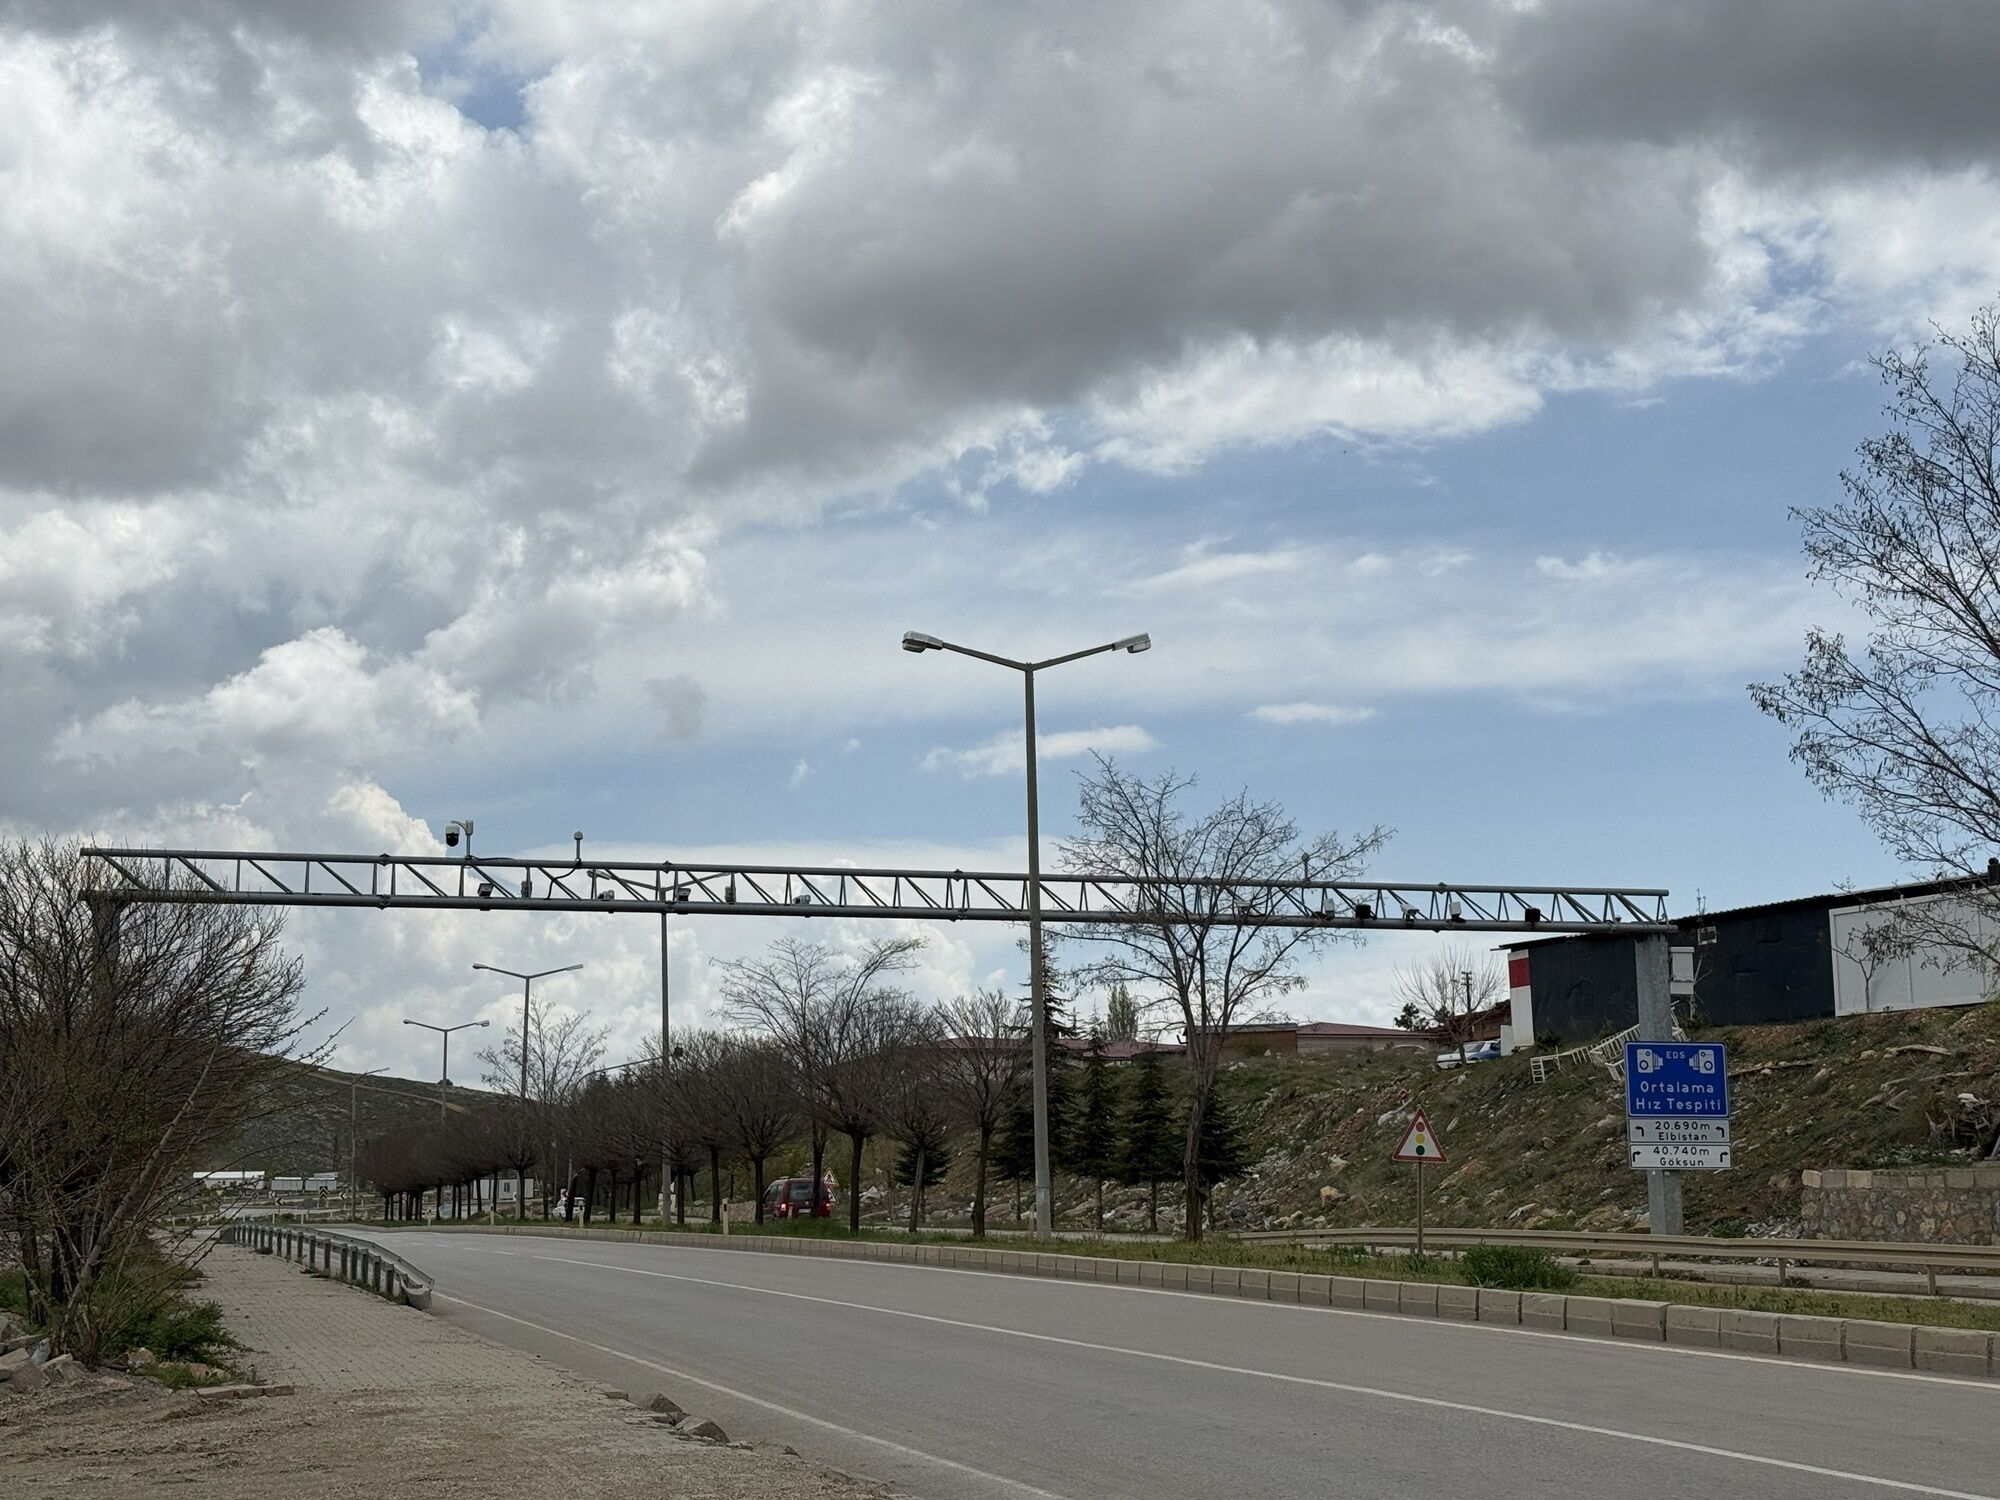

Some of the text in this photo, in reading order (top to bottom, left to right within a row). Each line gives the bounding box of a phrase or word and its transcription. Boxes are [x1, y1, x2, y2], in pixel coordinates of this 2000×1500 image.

[1640, 1081, 1714, 1093] Ortalama
[1636, 1098, 1721, 1112] Hız Tespiti
[1654, 1121, 1711, 1130] 20.690m
[1658, 1132, 1708, 1141] Elbistan
[1653, 1146, 1709, 1155] 40.740m
[1659, 1157, 1704, 1166] Göksun
